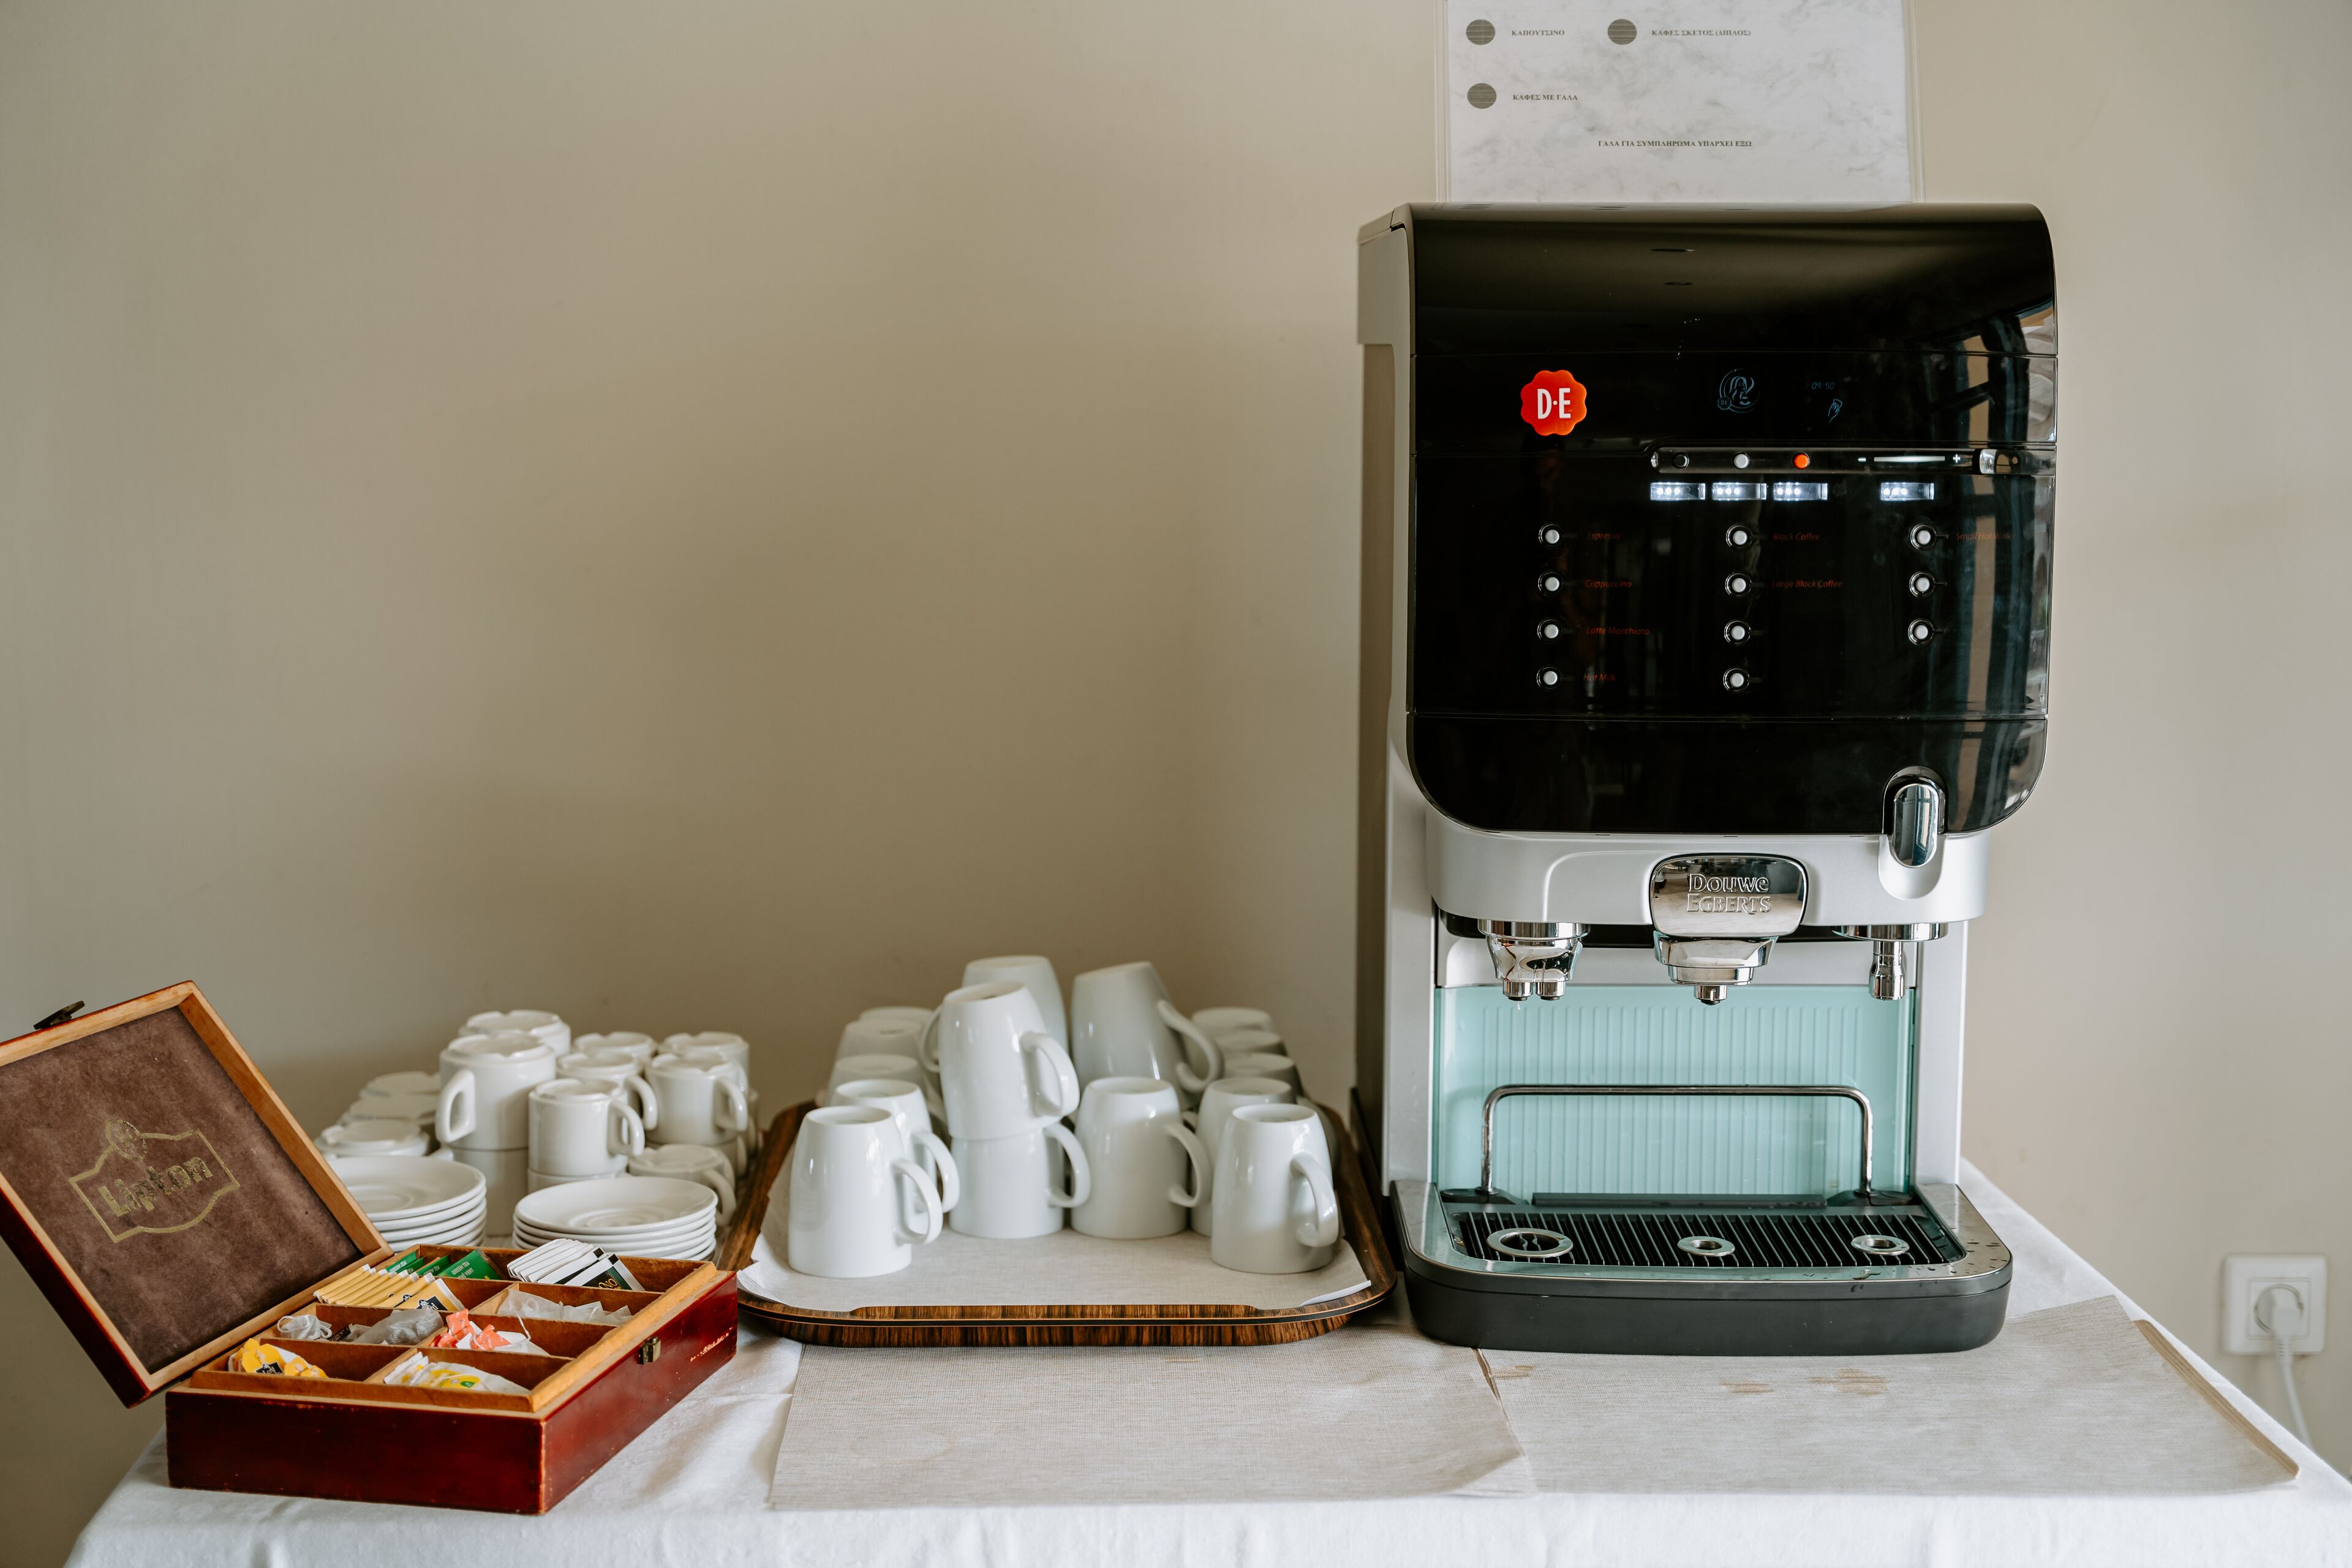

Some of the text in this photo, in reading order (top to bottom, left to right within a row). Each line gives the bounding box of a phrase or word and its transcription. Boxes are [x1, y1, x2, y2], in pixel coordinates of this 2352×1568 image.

[1587, 531, 1621, 541] Espresso
[1584, 579, 1632, 589] Cappuccino
[1771, 579, 1843, 590] Large Black Coffee
[1583, 672, 1616, 682] Hot Milk
[1688, 873, 1770, 893] Douwe
[1686, 893, 1772, 914] EGBERTS
[98, 1156, 213, 1217] Lipton
[451, 1265, 464, 1275] GREEN
